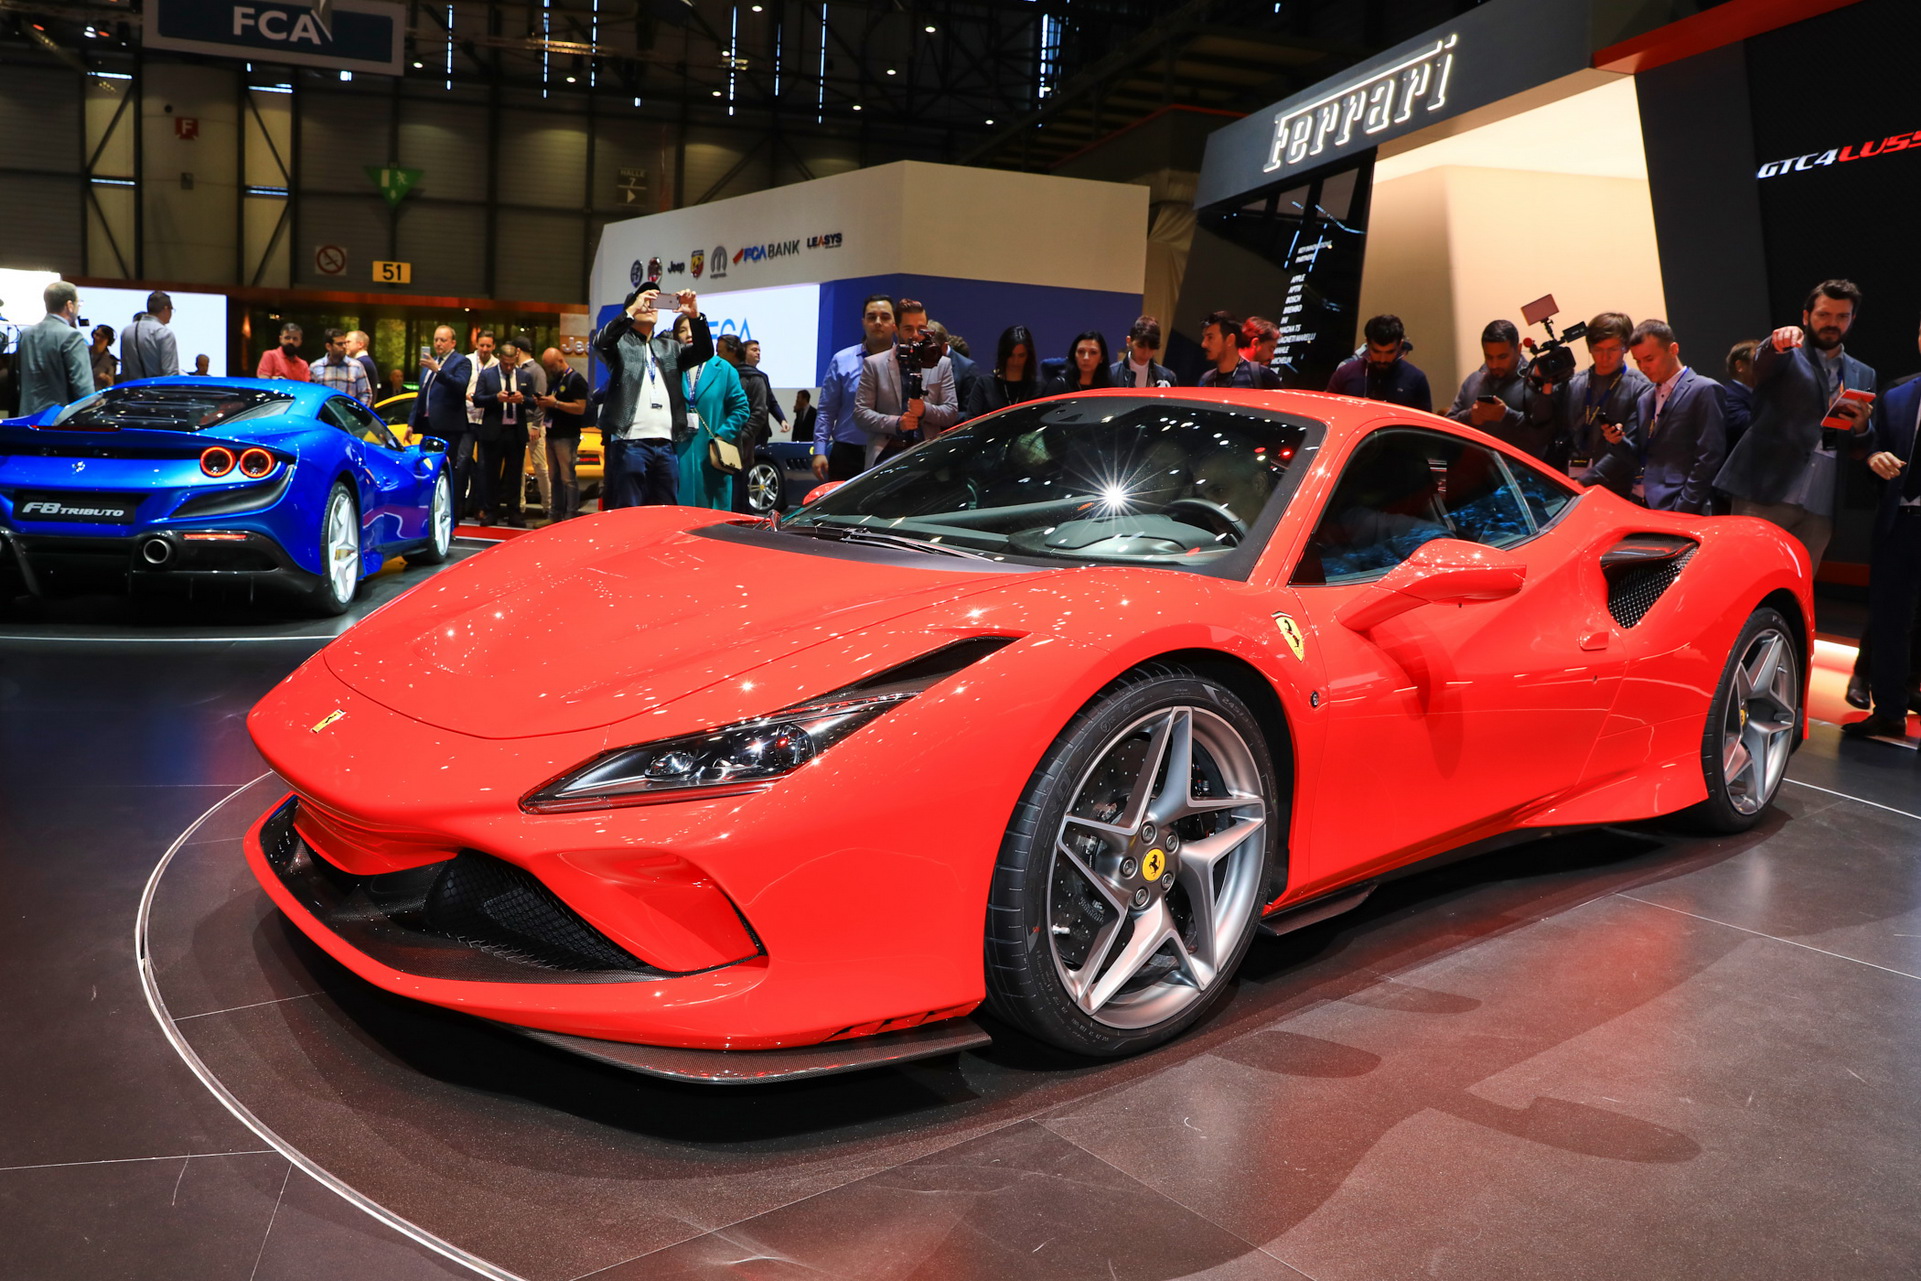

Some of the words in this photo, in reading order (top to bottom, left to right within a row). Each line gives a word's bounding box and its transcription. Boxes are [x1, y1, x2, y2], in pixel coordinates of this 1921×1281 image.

[233, 6, 321, 45] FCA
[1263, 33, 1458, 174] Ferrari
[182, 119, 193, 134] F
[807, 233, 843, 249] LEASYS
[744, 246, 767, 262] FCA
[768, 239, 800, 259] BANK
[383, 263, 401, 281] 51
[668, 261, 686, 275] Jeep
[22, 501, 62, 514] F8
